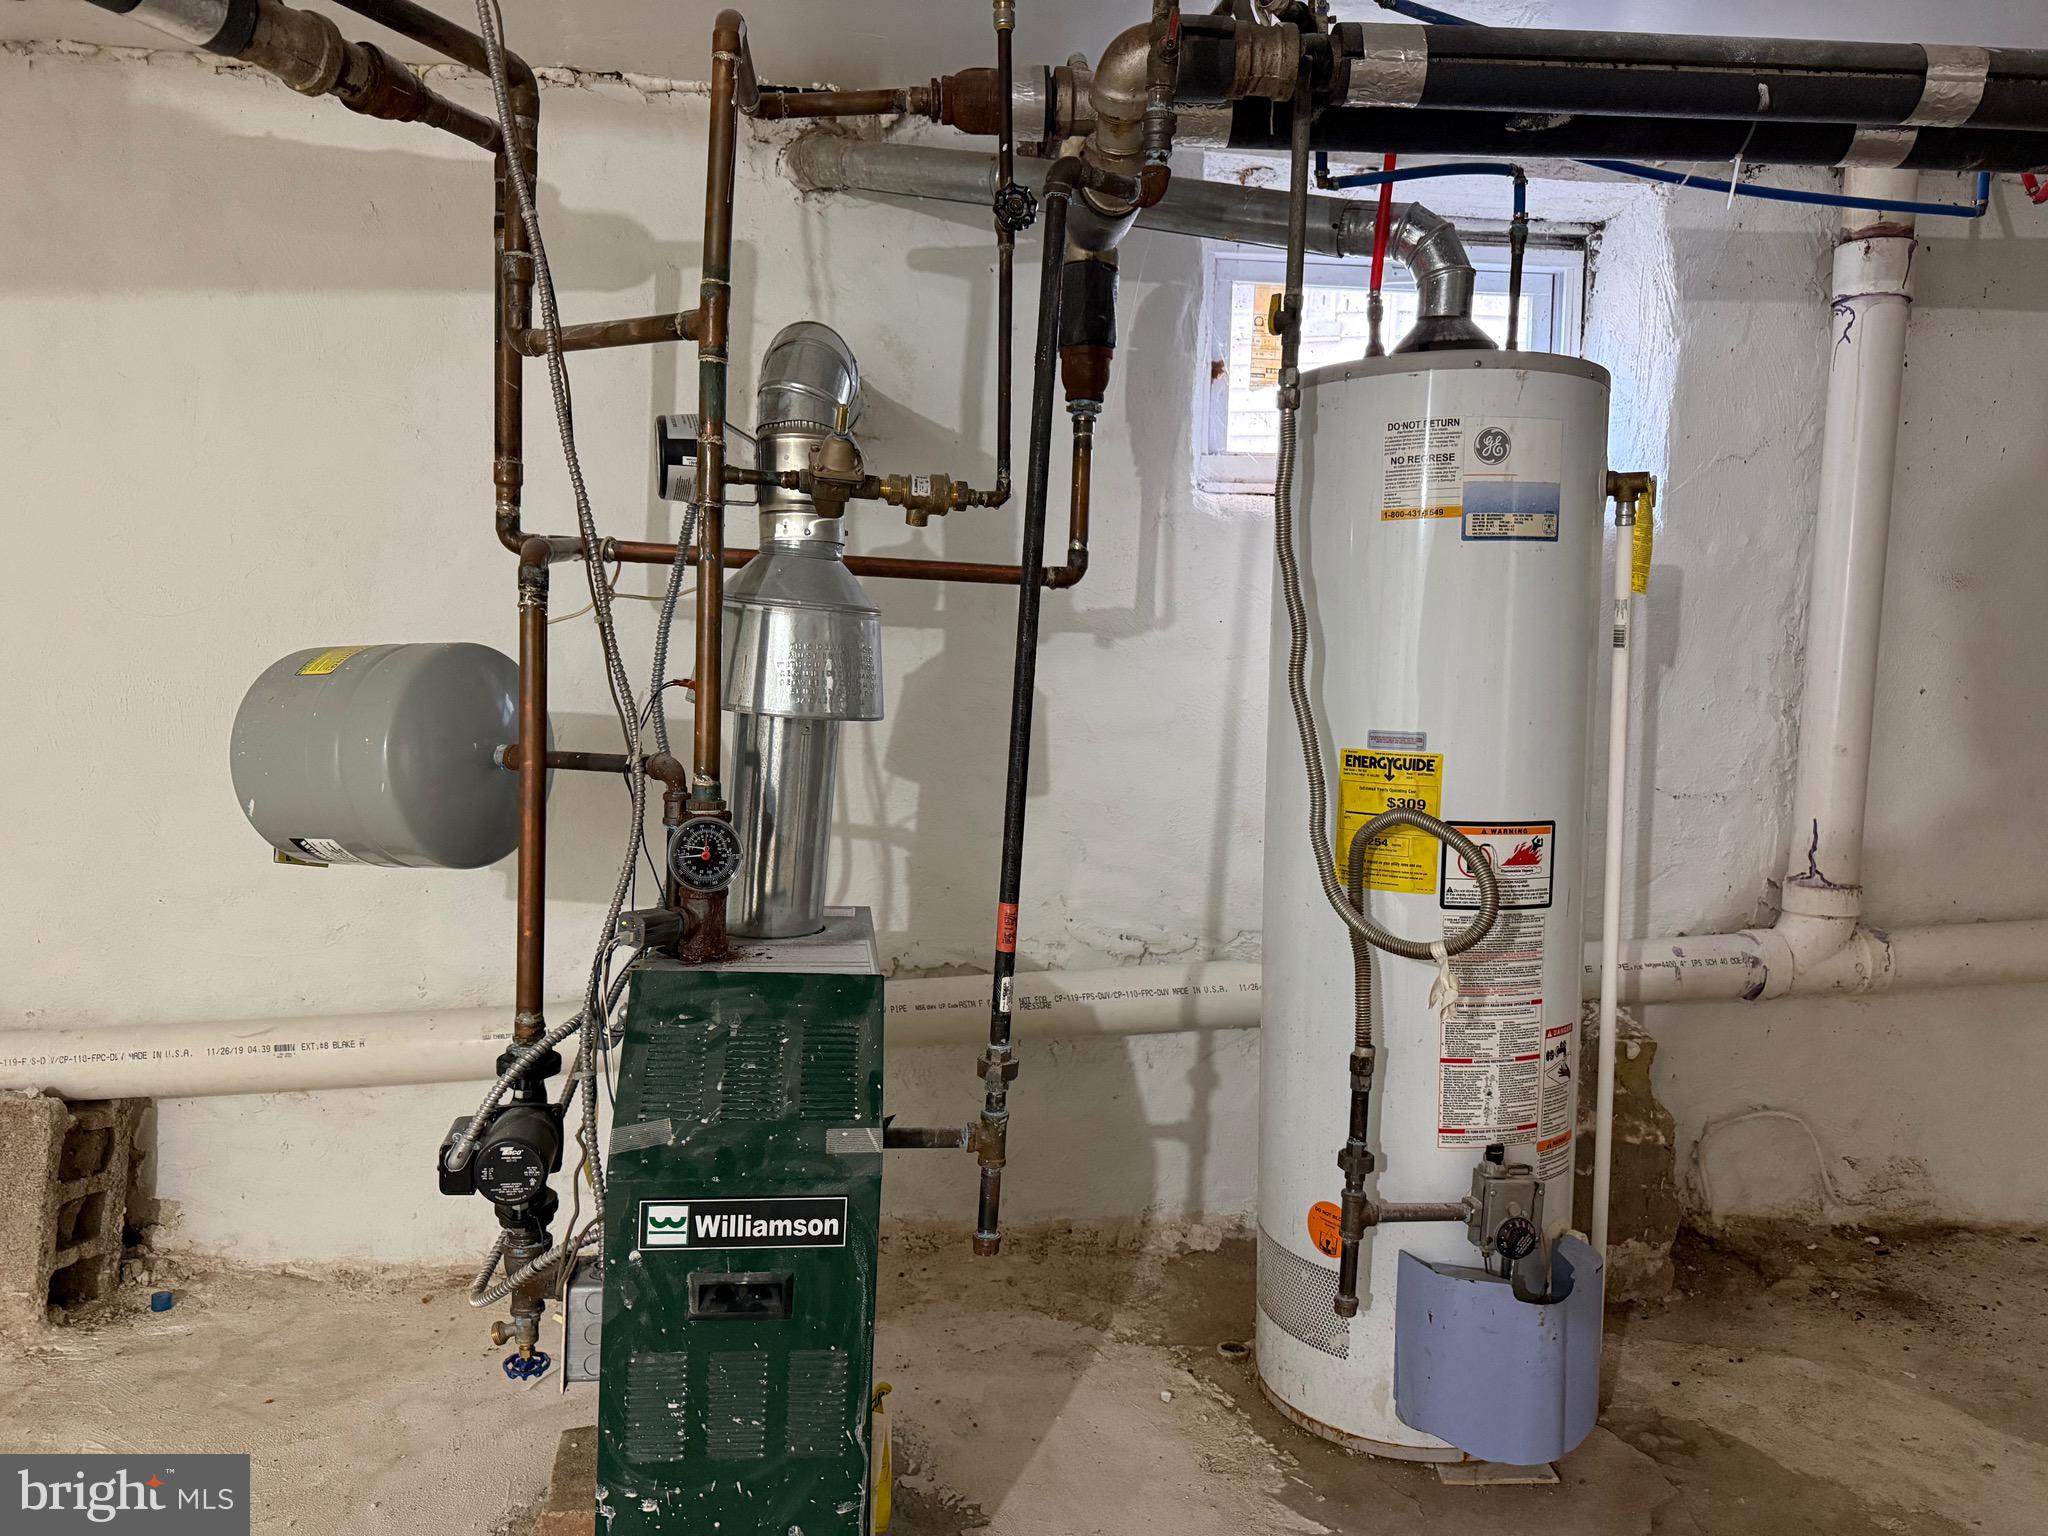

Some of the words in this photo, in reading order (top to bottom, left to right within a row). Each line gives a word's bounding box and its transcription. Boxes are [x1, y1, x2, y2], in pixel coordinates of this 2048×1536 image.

[1387, 422, 1401, 432] DO
[1402, 420, 1421, 430] NOT
[1390, 456, 1405, 465] NO
[1345, 753, 1436, 773] ENERGYGUIDE
[1386, 797, 1427, 810] $309
[1367, 837, 1388, 847] 254
[1172, 986, 1189, 995] MADE
[1193, 986, 1201, 994] IN
[1203, 985, 1228, 994] U.S.A.
[890, 1004, 908, 1013] PIPE
[1019, 1001, 1052, 1010] PRESSURE
[332, 1040, 356, 1049] BLAKE
[153, 1050, 162, 1059] IN
[166, 1049, 193, 1058] U.S.A.
[207, 1046, 244, 1056] 11/26/19
[695, 1213, 840, 1239] Williamson
